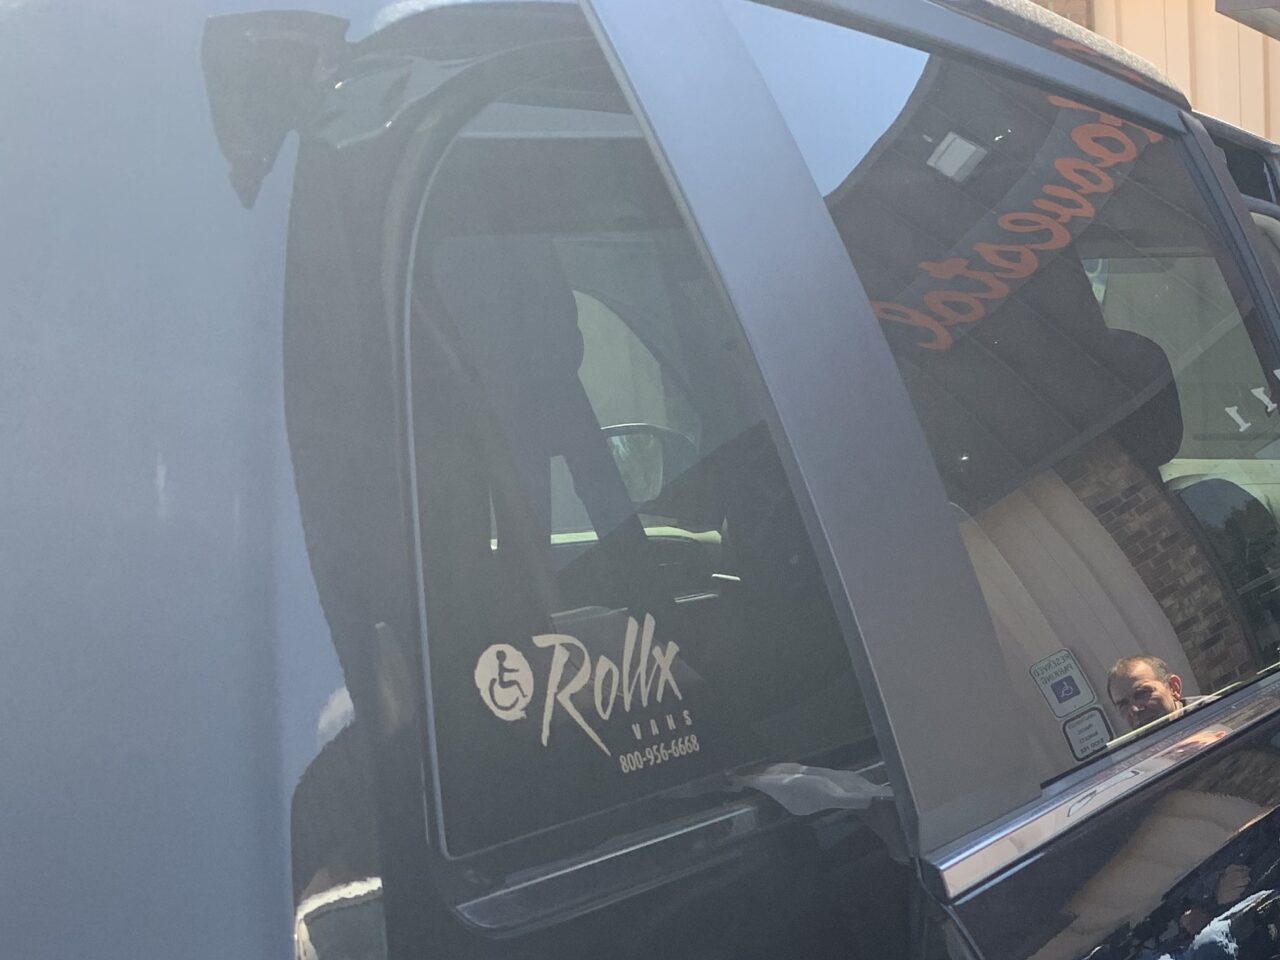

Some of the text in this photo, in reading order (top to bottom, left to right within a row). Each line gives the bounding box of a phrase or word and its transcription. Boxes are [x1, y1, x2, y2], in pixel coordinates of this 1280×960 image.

[532, 613, 683, 758] Rollx
[631, 710, 693, 740] VANS
[619, 734, 700, 774] 800-956-6668
